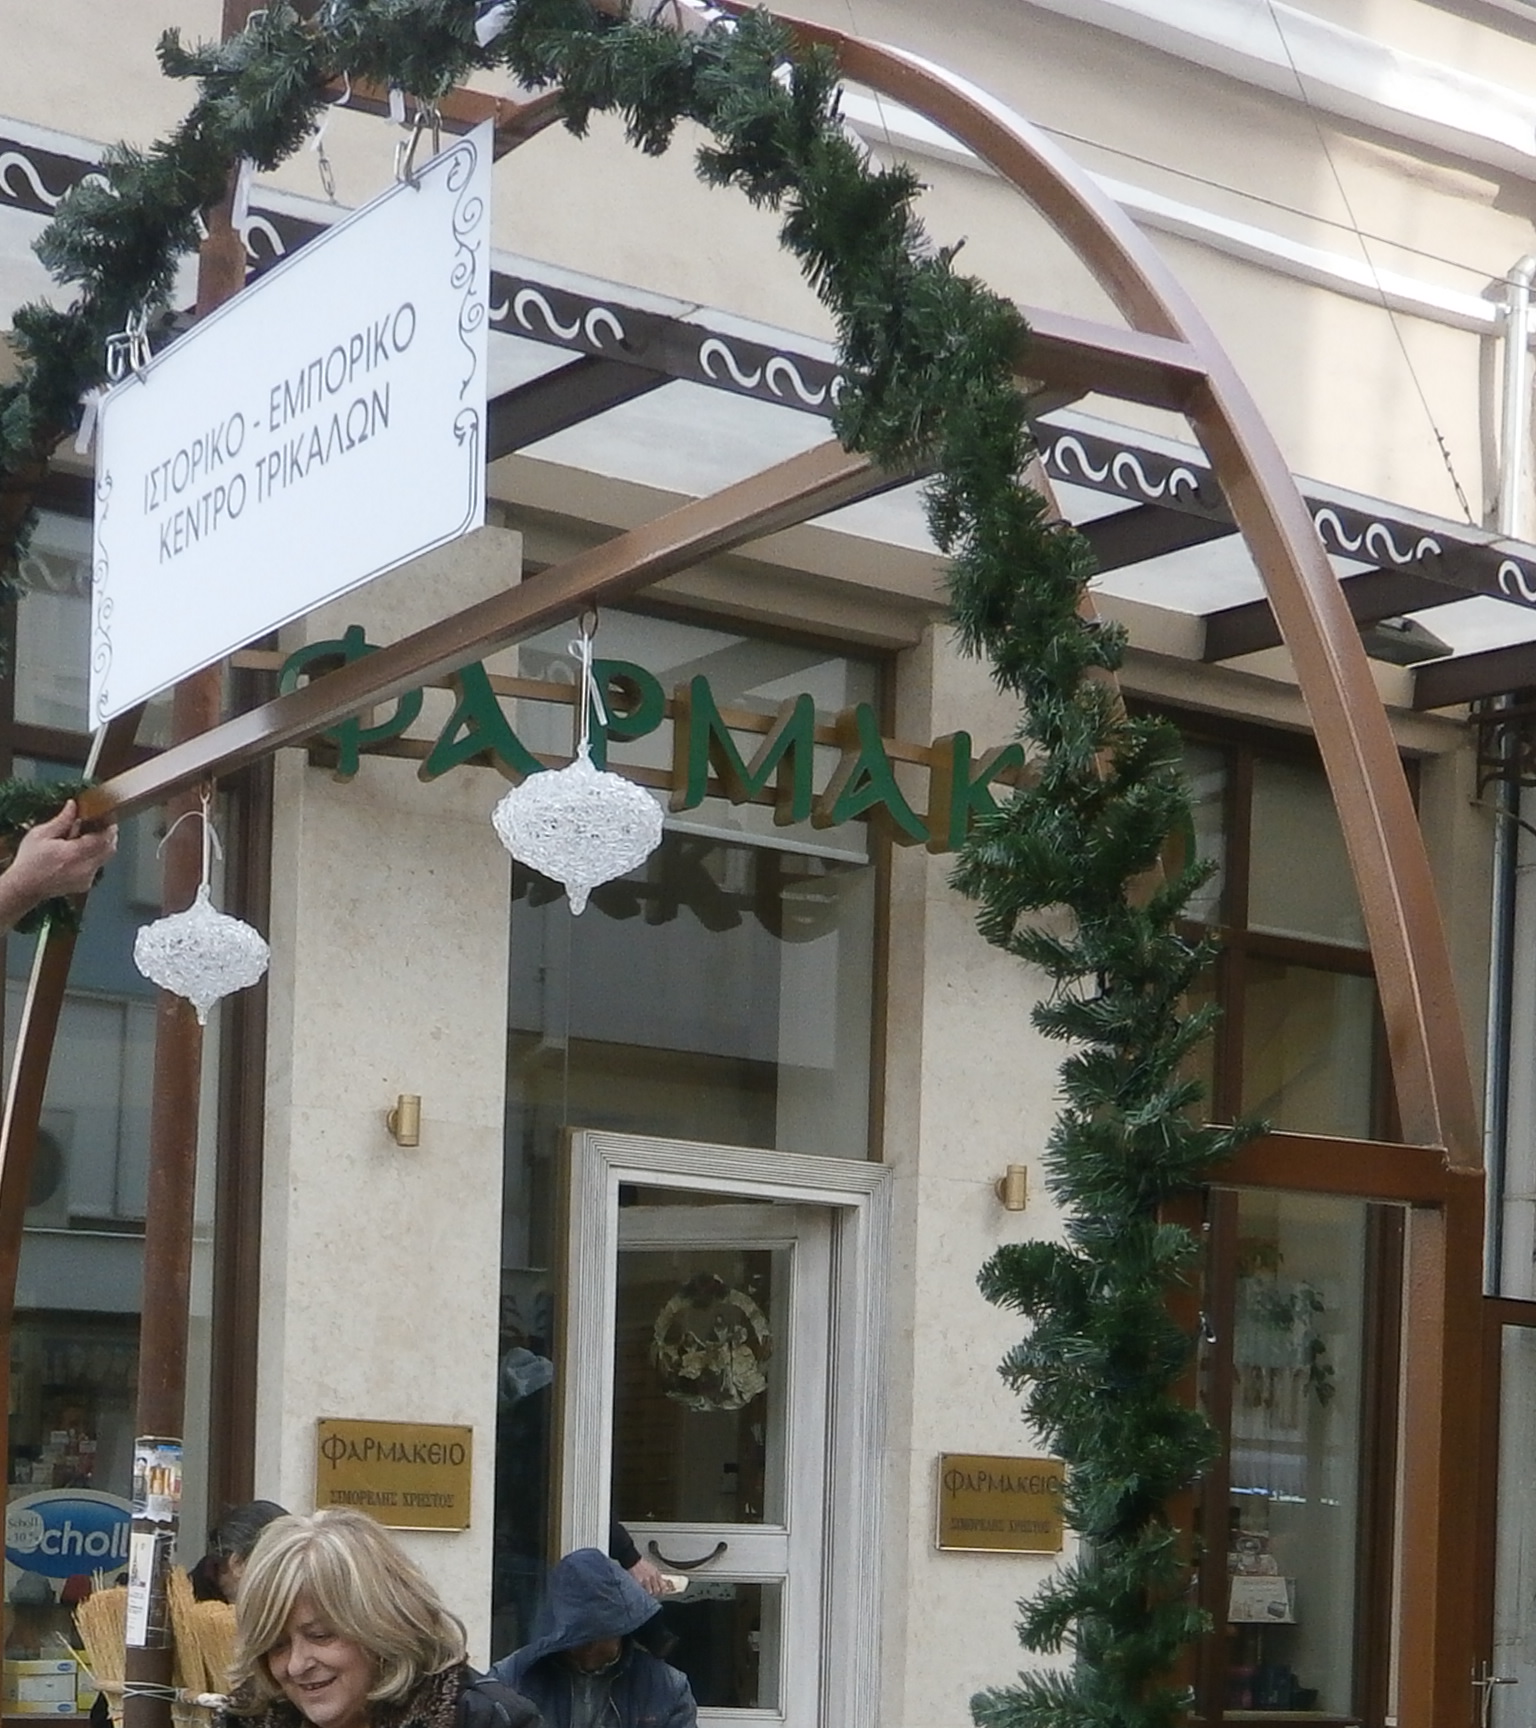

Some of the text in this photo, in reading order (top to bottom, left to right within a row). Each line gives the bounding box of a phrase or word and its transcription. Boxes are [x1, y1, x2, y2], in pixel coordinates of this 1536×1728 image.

[143, 412, 245, 515] ΙΣΤΟΡΙΚΟ
[269, 302, 416, 432] ΕΜΠΟΡΙΚΟ
[160, 381, 390, 565] ΚΕΝΤΡΟ ΤΡΙΚΑΛΩΝ
[277, 625, 1197, 885] ΦΑΡΜΑΚ
[17, 1520, 130, 1559] choll
[321, 1433, 465, 1470] ΦΑΡΜΑΚΕΙΟ
